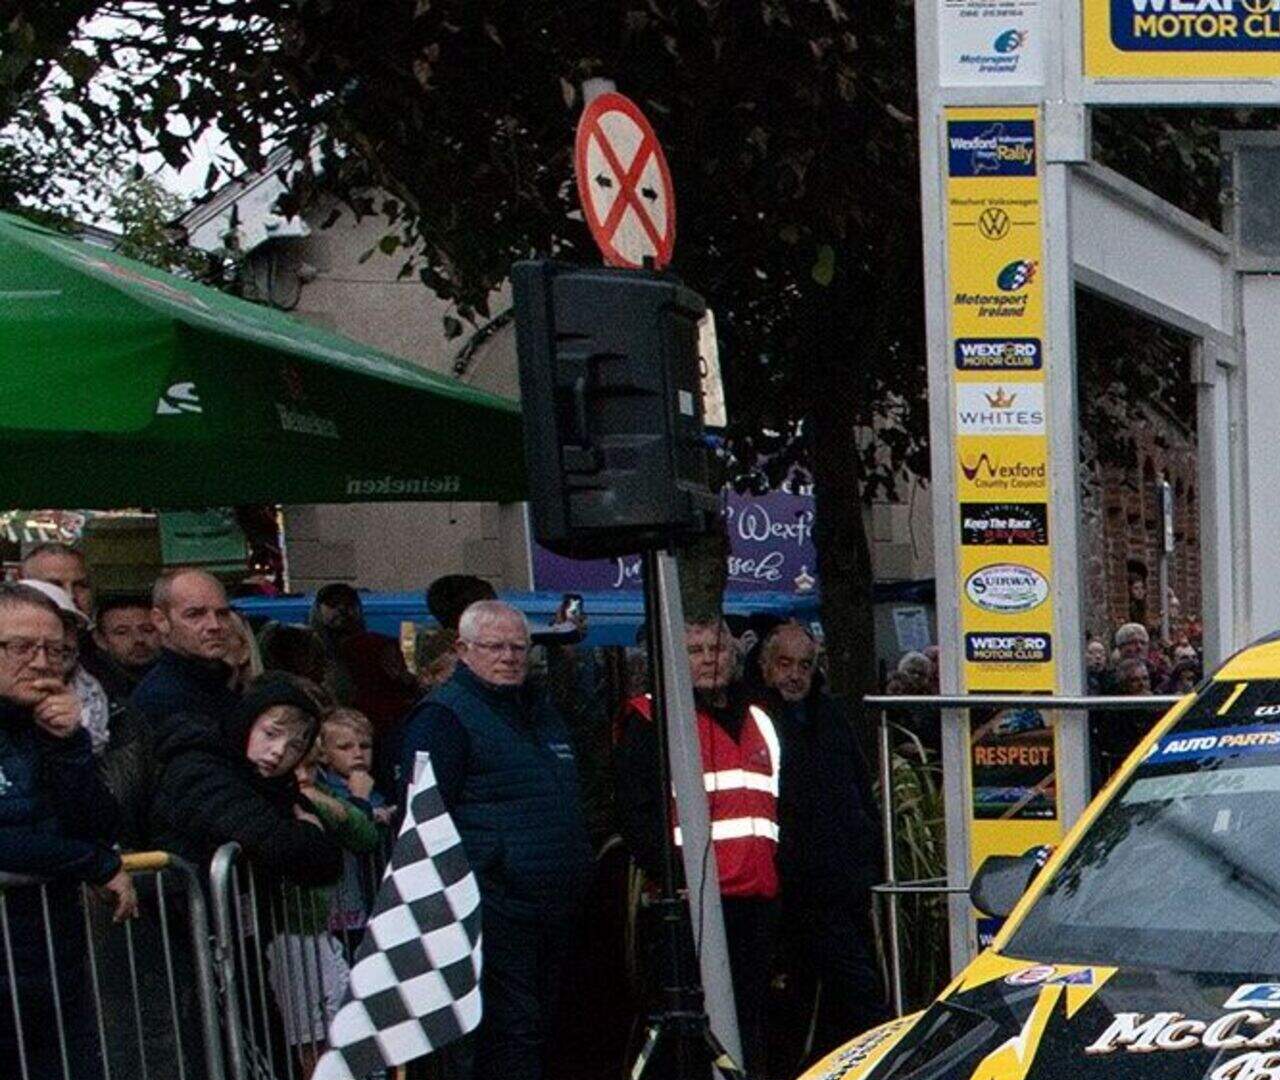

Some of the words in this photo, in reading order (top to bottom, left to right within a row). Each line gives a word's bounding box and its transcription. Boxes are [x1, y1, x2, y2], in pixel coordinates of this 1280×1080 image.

[1134, 14, 1238, 37] MOTOR
[950, 137, 998, 150] Wexford
[998, 144, 1033, 165] Rally
[954, 293, 1028, 307] Motorsport
[978, 306, 1025, 318] Ireland
[960, 343, 1037, 357] WEXFORD
[963, 357, 1002, 366] MOTOR
[1004, 357, 1034, 367] CLUB
[958, 412, 1044, 425] WHITES
[960, 453, 1046, 482] Wexford
[975, 479, 1009, 490] County
[1010, 479, 1045, 489] Council
[738, 503, 812, 546] Wexf
[963, 519, 990, 531] Keep
[990, 518, 1007, 530] The
[1007, 519, 1032, 530] Race
[970, 637, 1046, 650] WEXFORD
[1163, 735, 1219, 755] AUTO
[974, 746, 1050, 765] RESPECT
